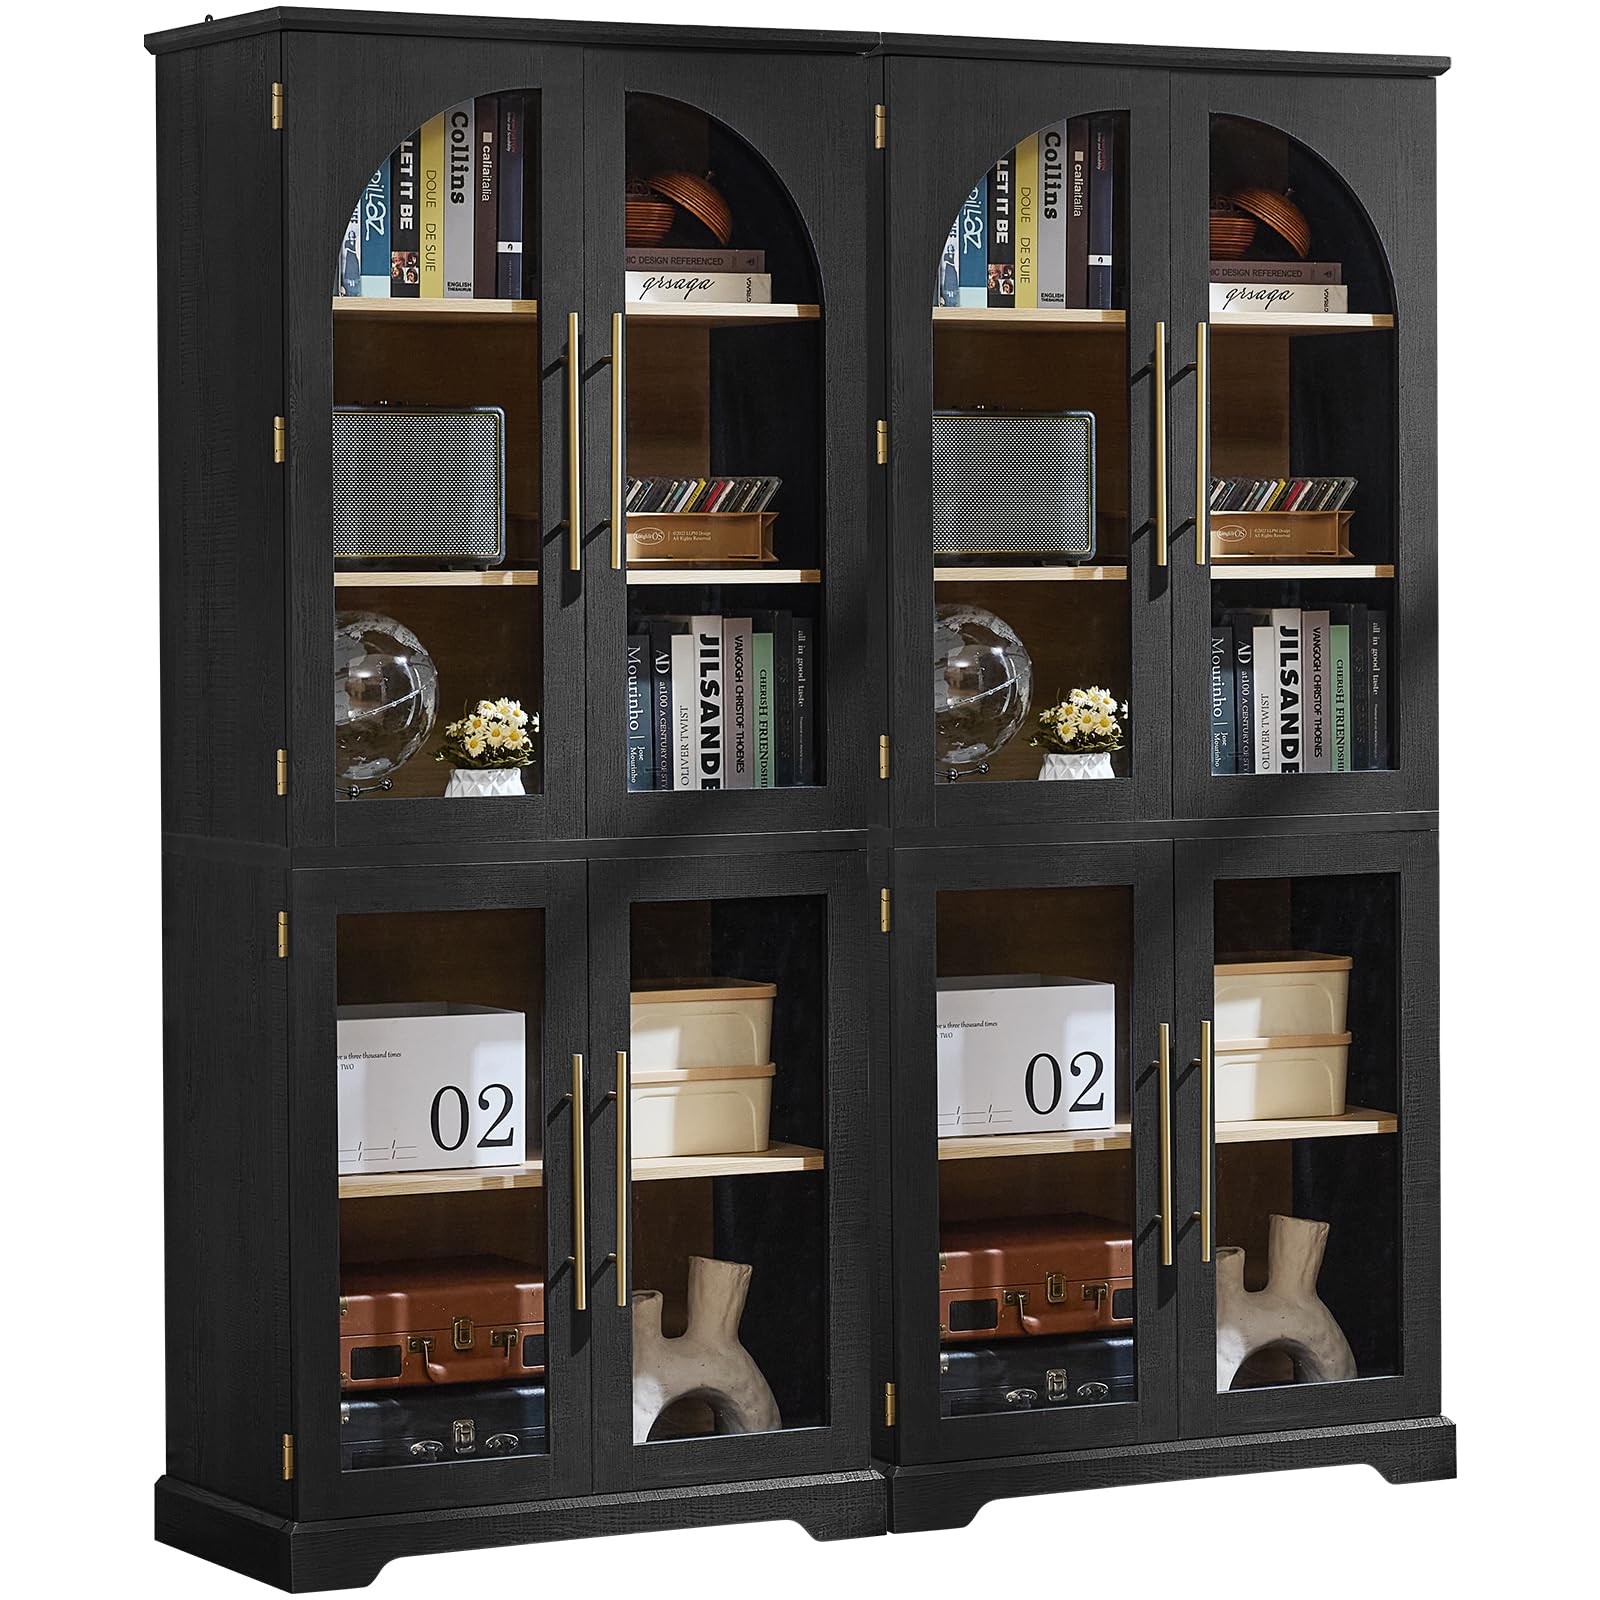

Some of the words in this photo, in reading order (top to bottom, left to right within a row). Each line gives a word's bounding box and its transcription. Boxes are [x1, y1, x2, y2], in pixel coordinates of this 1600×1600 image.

[400, 140, 414, 177] LET
[451, 111, 469, 204] Collins
[482, 145, 493, 202] caliaitalia
[1044, 131, 1062, 220] Collins
[400, 181, 414, 200] IT
[426, 170, 437, 208] DOUE
[996, 159, 1009, 194] LET
[1073, 164, 1084, 217] caliaitalia
[400, 203, 414, 230] BE
[996, 198, 1009, 215] IT
[1020, 187, 1031, 223] DOUE
[426, 223, 436, 241] DE
[996, 219, 1009, 244] BE
[1020, 237, 1030, 254] DE
[425, 244, 436, 272] SUIE
[639, 256, 668, 265] DESIGN
[671, 256, 724, 266] REFERENCED
[1020, 256, 1031, 284] SUIE
[1222, 268, 1250, 277] DESIGN
[1252, 269, 1303, 278] REFERENCED
[797, 630, 806, 642] all
[1372, 622, 1381, 634] all
[1372, 636, 1381, 646] in
[655, 650, 671, 674] AD
[734, 635, 744, 683] VANGOGH
[797, 645, 806, 655] in
[1238, 641, 1252, 664] AD
[1312, 627, 1322, 673] VANGOGH
[1371, 648, 1381, 673] good
[795, 657, 806, 683] good
[1211, 637, 1227, 718] Mourinho
[1241, 670, 1250, 695] at100
[1336, 659, 1345, 704] CHERISH
[627, 646, 644, 731] Mourinho
[659, 681, 667, 708] at100
[759, 668, 768, 717] CHERISH
[1280, 625, 1299, 773] JILSANDE
[1313, 674, 1322, 716] CHRISTOF
[680, 705, 689, 740] TWIST
[700, 634, 720, 789] JILSANDE
[734, 685, 744, 729] CHRISTOF
[1241, 704, 1250, 744] CENTURY
[1261, 693, 1269, 728] TWIST
[638, 745, 646, 761] Jose
[659, 715, 667, 758] CENTURY
[735, 731, 745, 774] THOENES
[1213, 732, 1221, 768] Mourinho
[1220, 731, 1228, 746] Jose
[1261, 729, 1270, 770] OLIVER
[1313, 718, 1323, 758] THOENES
[1336, 707, 1345, 771] FRIENDSHI
[630, 746, 638, 784] Mourinho
[680, 742, 690, 786] OLIVER
[961, 1020, 984, 1028] thousand
[349, 1052, 361, 1060] three
[362, 1050, 387, 1059] thousand
[1025, 1051, 1105, 1115] 02
[430, 1083, 514, 1151] 02
